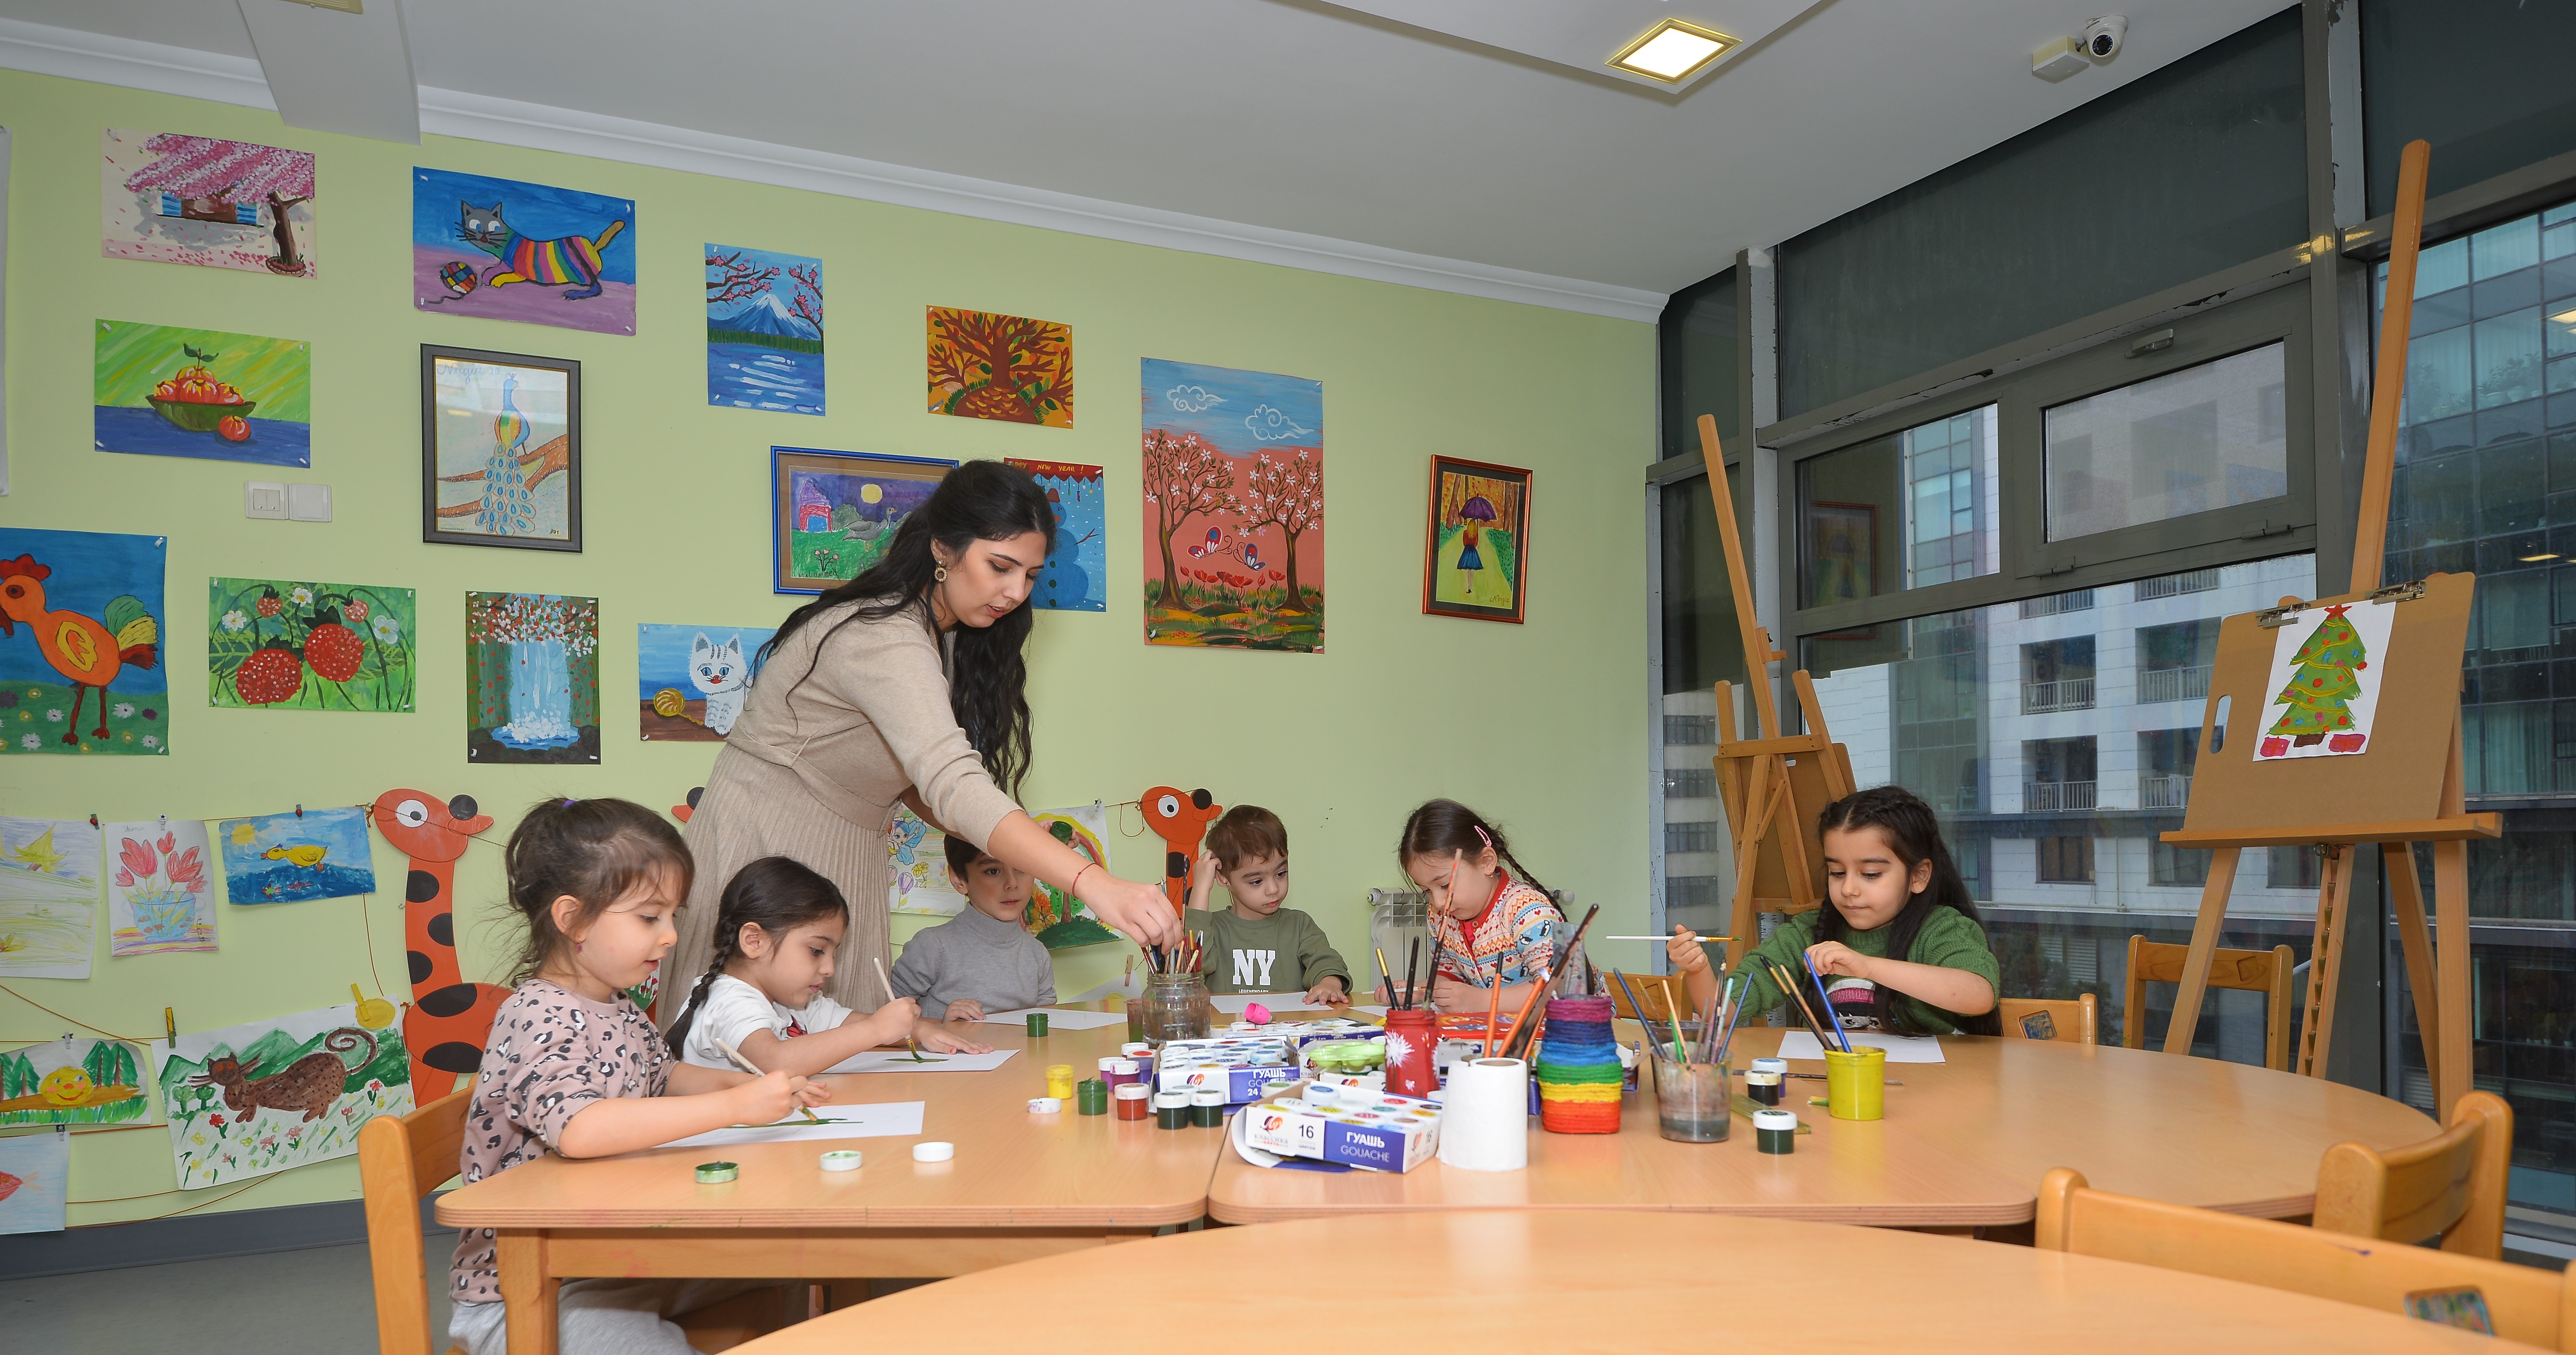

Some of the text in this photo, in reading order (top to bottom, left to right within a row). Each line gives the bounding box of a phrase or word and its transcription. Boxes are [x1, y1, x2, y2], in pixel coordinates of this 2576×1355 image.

[1233, 949, 1276, 985] NY
[1252, 1068, 1286, 1079] ГУАШЬ
[1247, 1088, 1258, 1096] 24
[1299, 1124, 1314, 1138] 16
[1346, 1131, 1385, 1148] ГУАШЬ
[1340, 1145, 1390, 1163] GOUACHE
